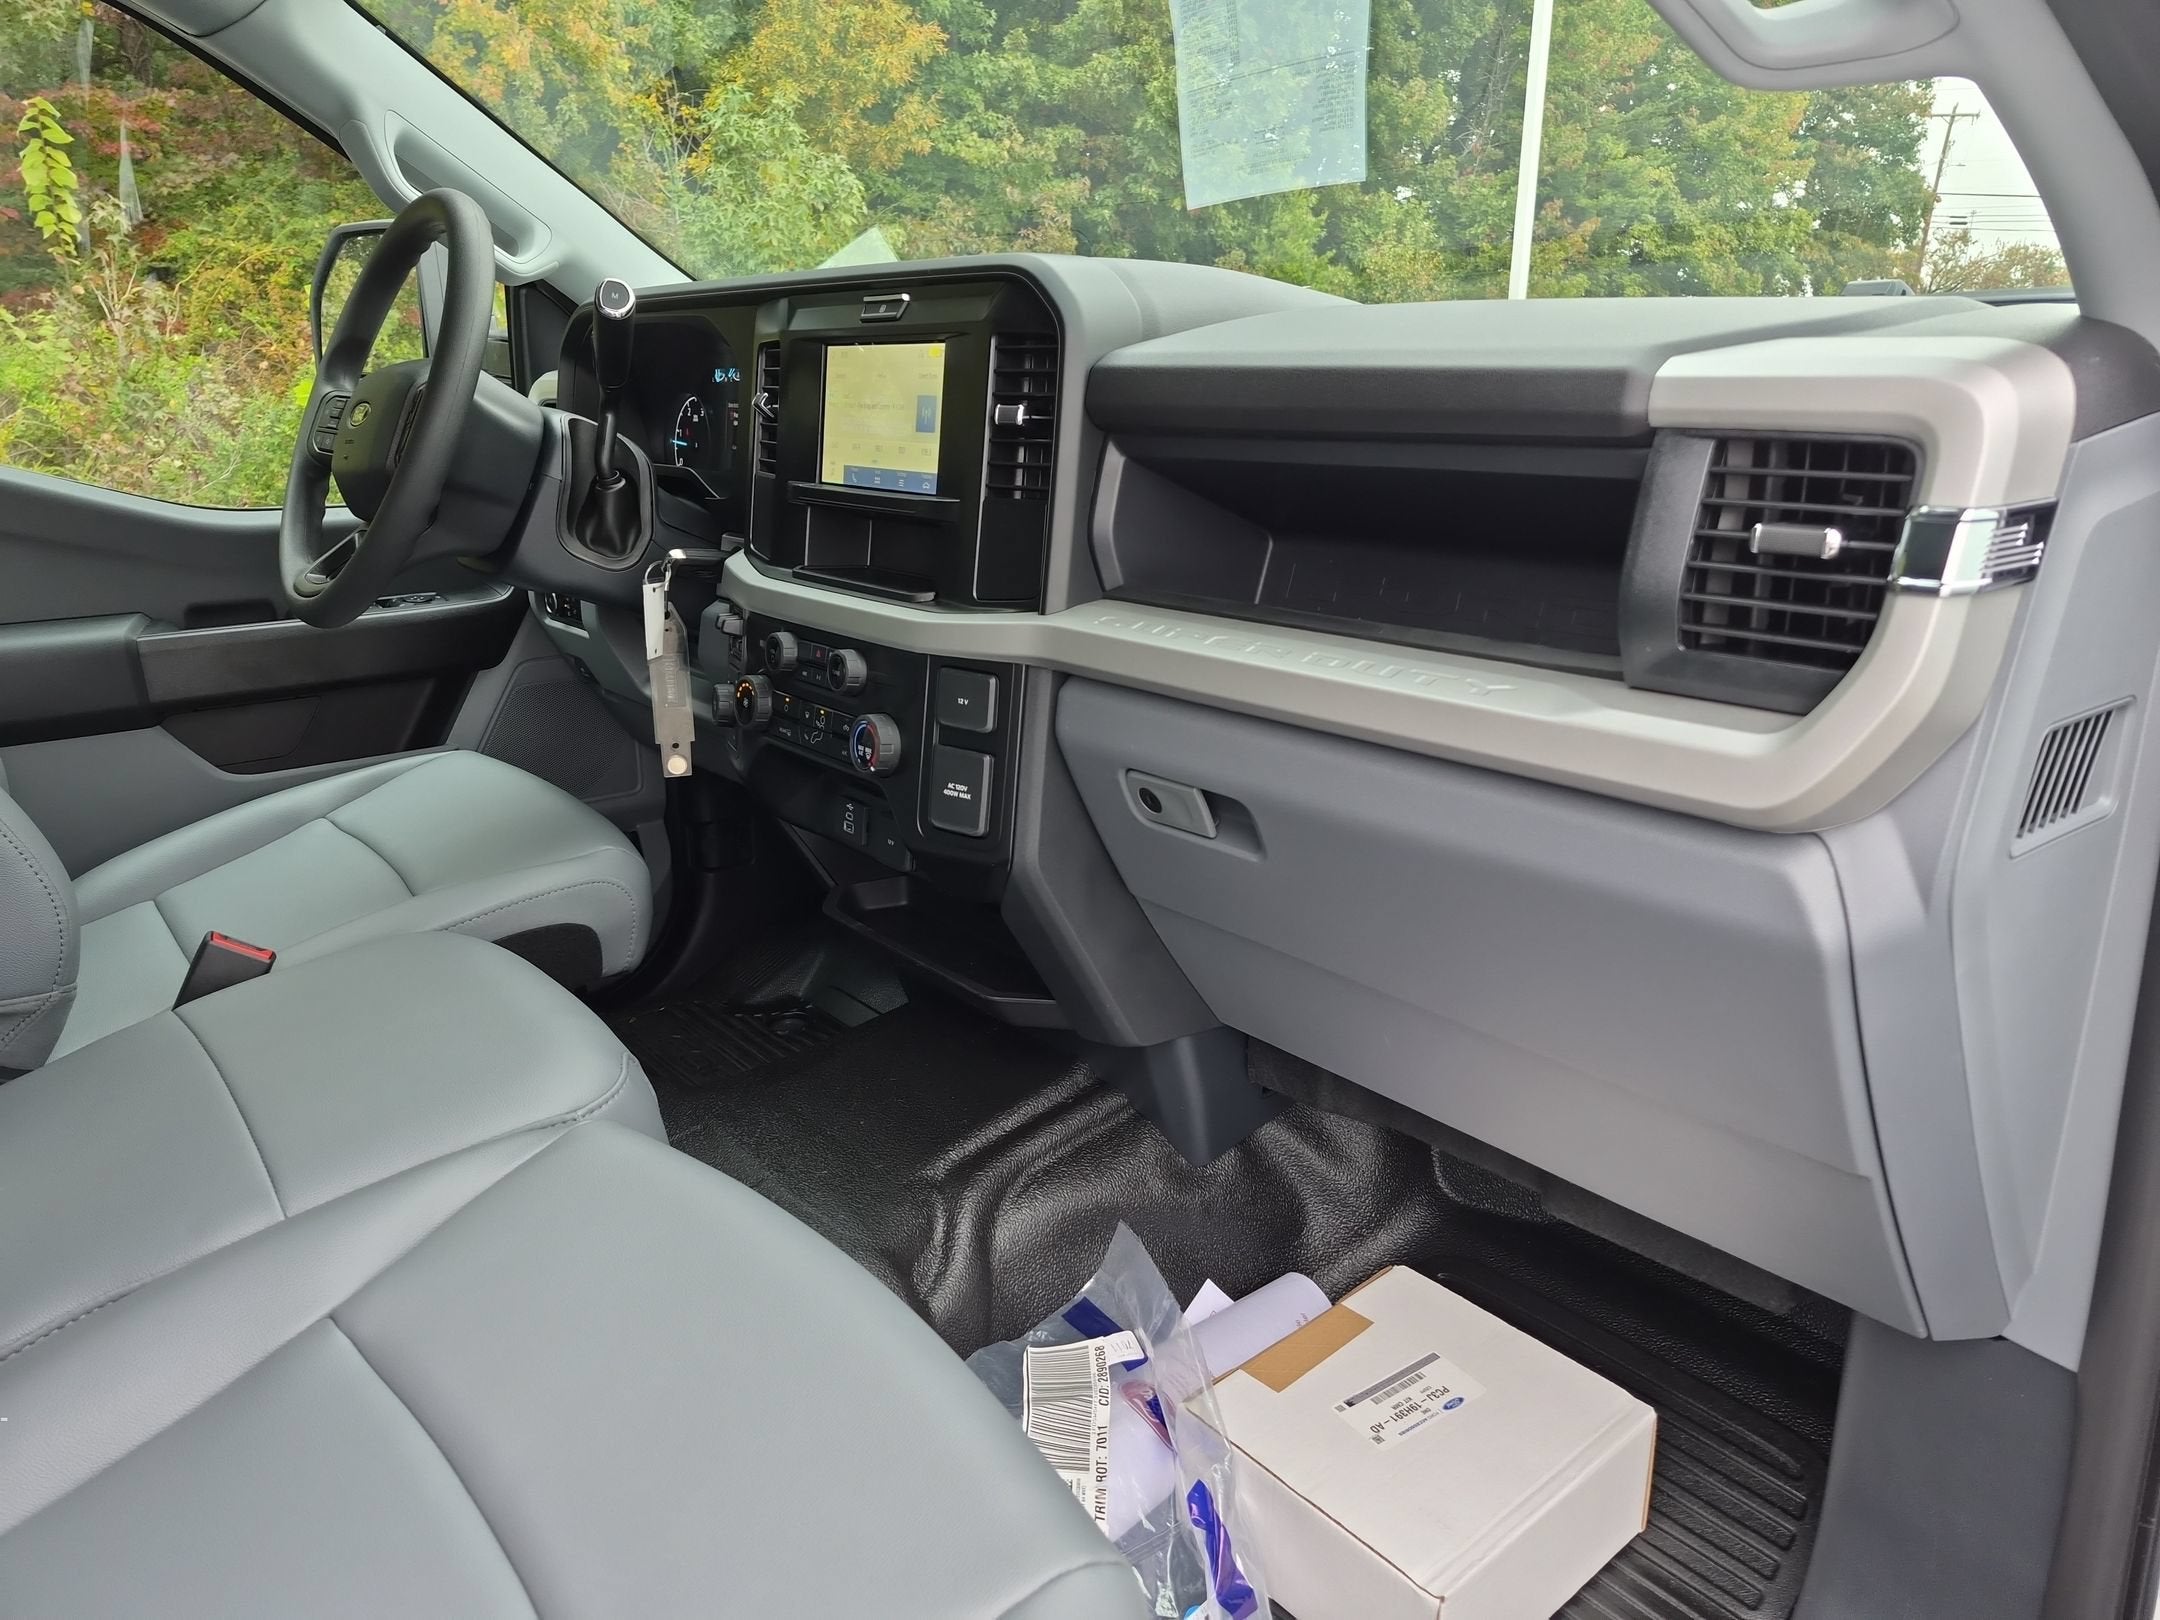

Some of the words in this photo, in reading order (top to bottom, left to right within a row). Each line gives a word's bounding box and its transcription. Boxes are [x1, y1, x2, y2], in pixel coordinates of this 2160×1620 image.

[1301, 651, 1518, 697] DUTY
[1094, 1345, 1109, 1383] 2890268
[1098, 1385, 1110, 1407] CID:
[1096, 1425, 1108, 1452] 7011
[1094, 1488, 1106, 1522] TRIM
